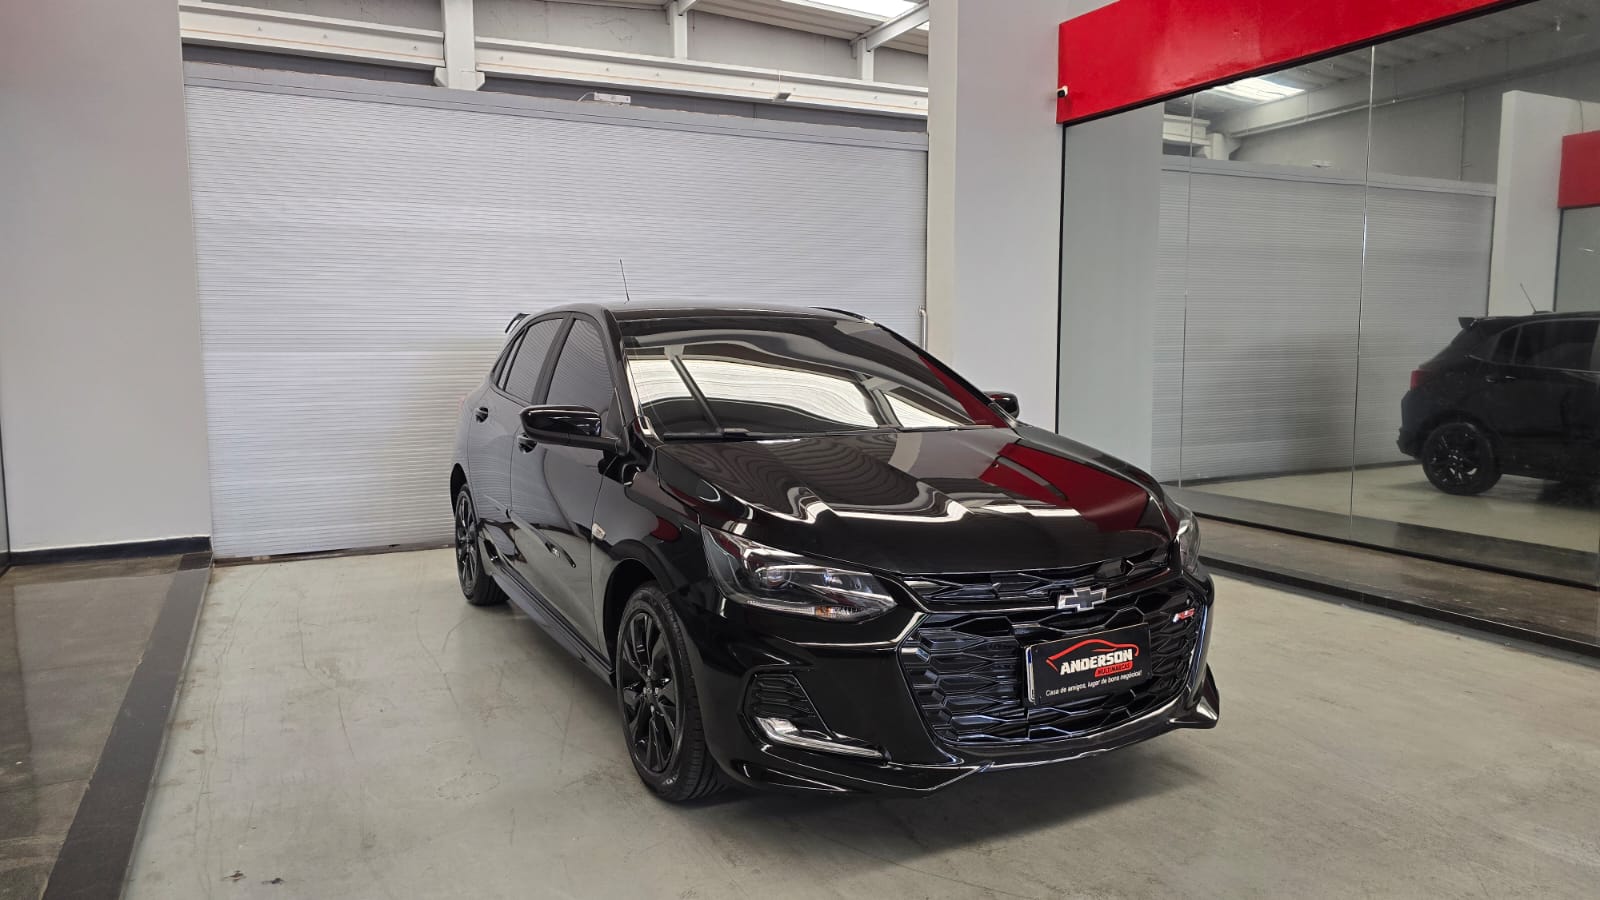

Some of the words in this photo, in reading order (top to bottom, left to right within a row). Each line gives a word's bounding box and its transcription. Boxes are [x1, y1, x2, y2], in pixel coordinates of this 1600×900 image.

[1060, 649, 1133, 675] ANDERSON
[1045, 689, 1059, 697] Casa
[1068, 683, 1087, 692] amigos,
[1087, 679, 1100, 688] lugar
[1100, 677, 1107, 685] de
[1107, 675, 1120, 683] bons
